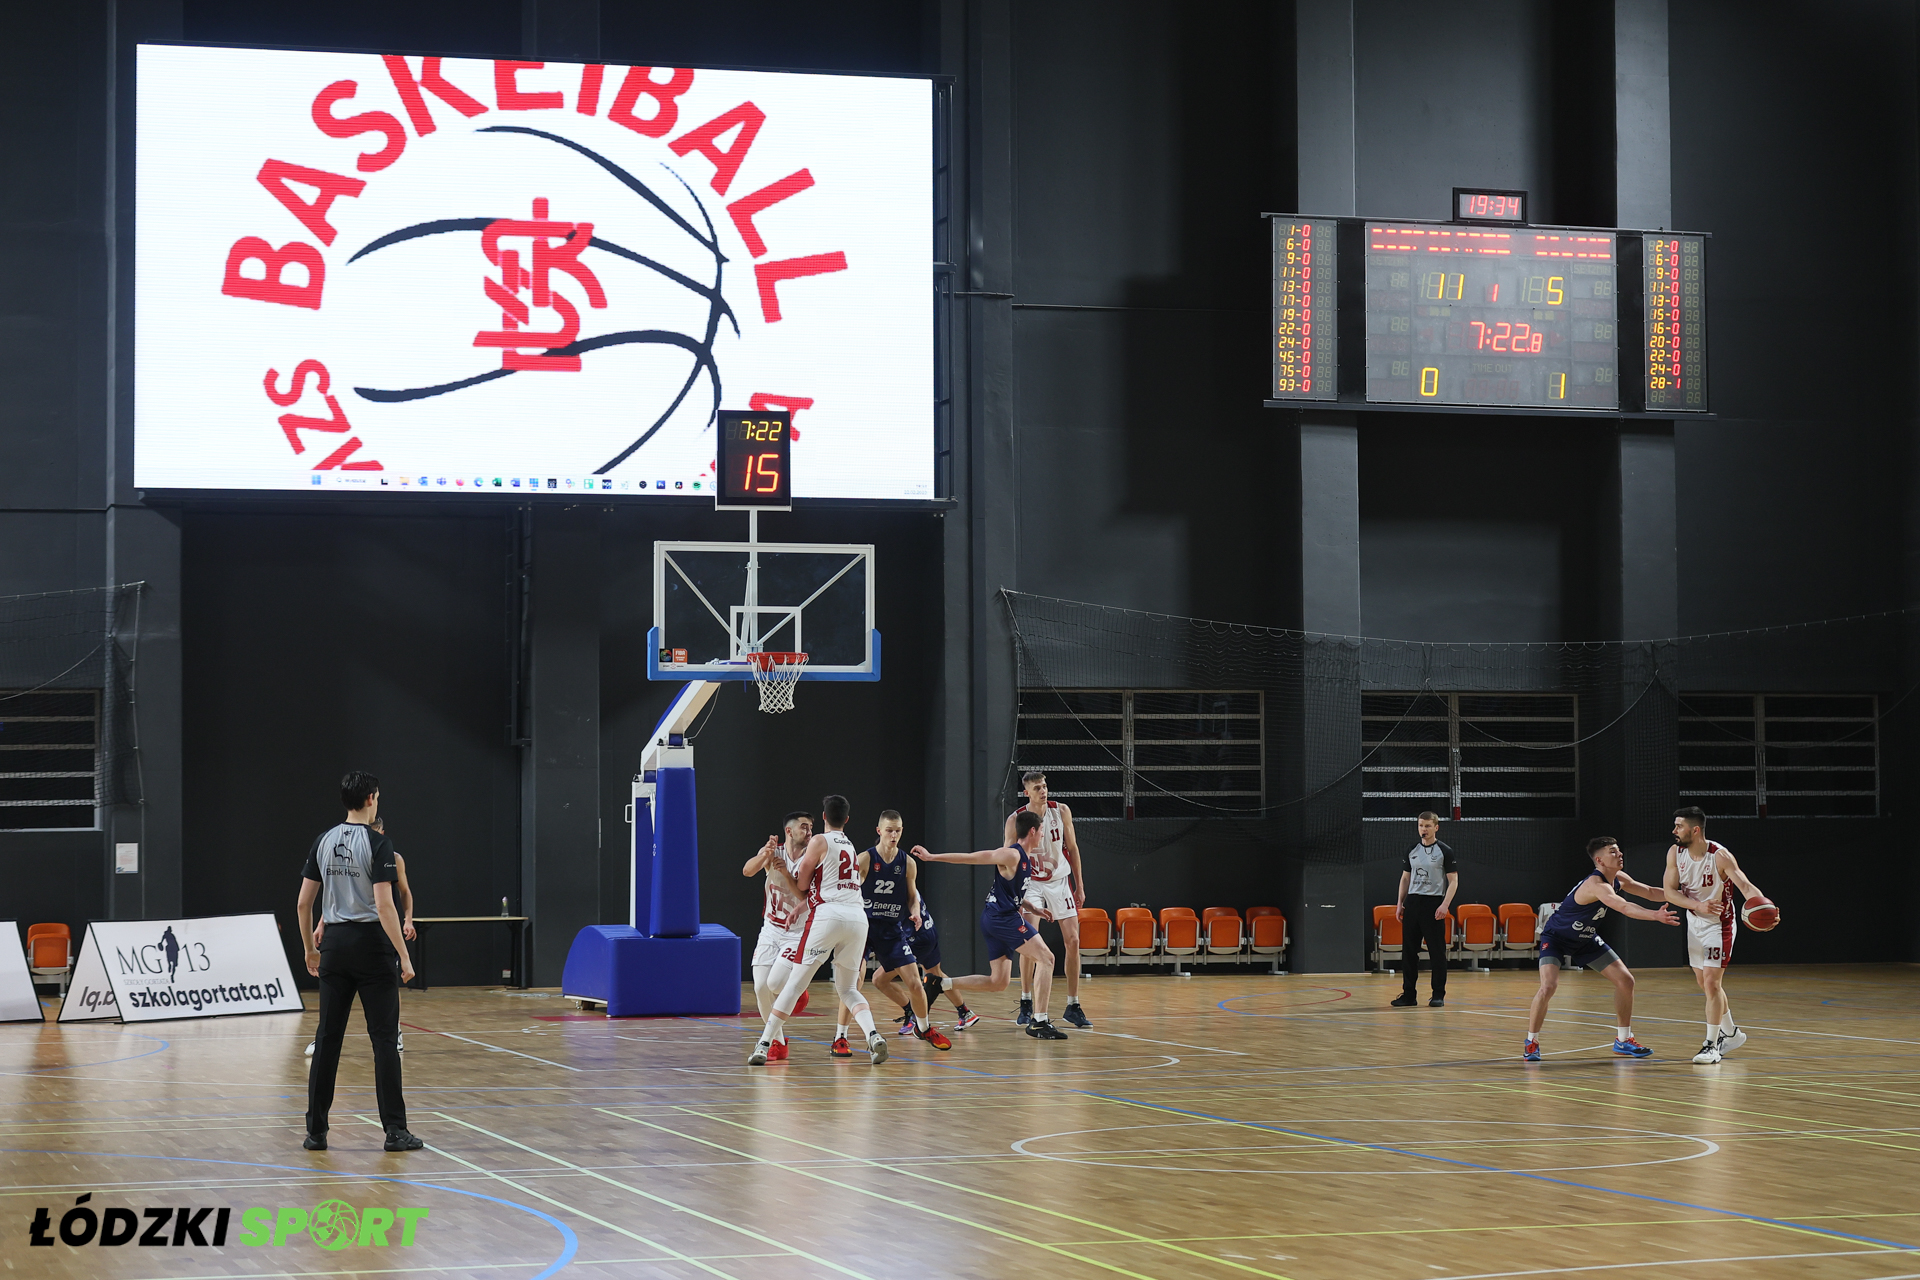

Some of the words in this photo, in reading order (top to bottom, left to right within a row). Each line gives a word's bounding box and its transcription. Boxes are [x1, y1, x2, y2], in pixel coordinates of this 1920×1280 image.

[1469, 194, 1520, 216] 19:34
[1290, 224, 1311, 238] 1-0
[1286, 238, 1311, 251] 6-0
[1656, 240, 1679, 253] 2-0
[1286, 252, 1311, 265] 9-0
[1656, 254, 1679, 267] 6-0
[1283, 266, 1311, 279] 11-0
[1656, 267, 1679, 280] 9-0
[1283, 280, 1311, 294] 13-0
[1437, 273, 1465, 300] 11
[1491, 284, 1500, 302] 1
[1546, 276, 1564, 305] 5
[1652, 281, 1680, 294] 11-0
[1283, 294, 1311, 308] 17-0
[1652, 295, 1680, 308] 13-0
[1283, 308, 1311, 321] 19-0
[1653, 308, 1680, 321] 15-0
[1278, 322, 1311, 336] 22-0
[1654, 322, 1680, 335] 16-0
[1278, 336, 1311, 350] 24-0
[1650, 336, 1680, 349] 20-0
[1279, 350, 1311, 364] 45-0
[1650, 349, 1681, 362] 22-0
[1280, 364, 1311, 378] 75-0
[1650, 363, 1681, 376] 24-0
[1279, 378, 1311, 392] 93-0
[1420, 367, 1440, 397] 0
[1558, 372, 1566, 399] 1
[1650, 377, 1682, 389] 28-1
[741, 421, 782, 441] 7:22
[745, 453, 779, 493] 15
[1050, 828, 1060, 842] 11
[874, 880, 895, 894] 22
[1702, 874, 1714, 887] 13
[872, 901, 902, 912] Energa
[1064, 897, 1075, 910] 11
[116, 944, 163, 974] MG
[181, 942, 211, 973] 13
[1708, 946, 1720, 960] 13
[129, 978, 284, 1010] szkolagortata.pl
